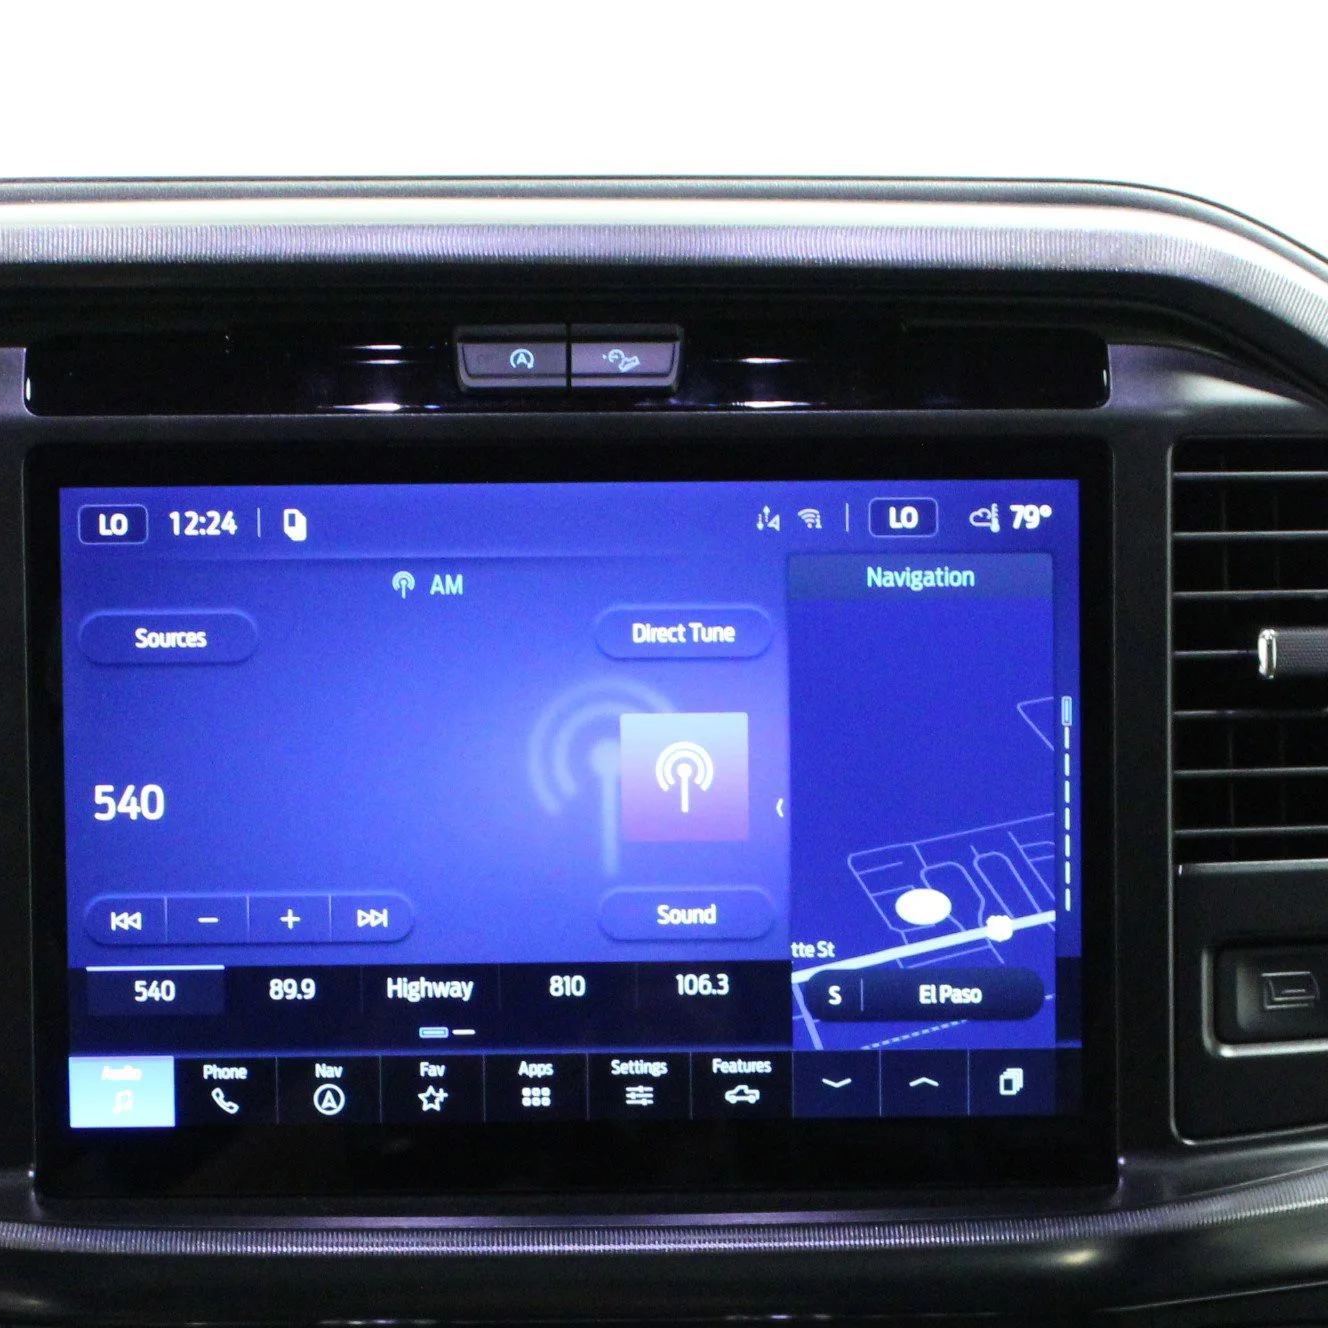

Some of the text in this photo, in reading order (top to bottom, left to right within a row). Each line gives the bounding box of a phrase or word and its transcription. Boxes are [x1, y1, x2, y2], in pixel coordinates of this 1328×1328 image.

[99, 513, 128, 535] LO
[170, 511, 237, 535] 12:24
[889, 506, 918, 529] LO
[430, 574, 463, 594] AM
[867, 567, 975, 591] Navigation
[135, 628, 207, 648] Sources
[633, 623, 735, 643] Direct Tune
[95, 784, 164, 820] 540
[657, 904, 716, 924] Sound
[817, 940, 835, 958] St
[135, 980, 175, 1002] 540
[270, 978, 315, 1000] 89.9
[387, 977, 473, 1002] Highway
[550, 975, 586, 996] 810
[676, 974, 729, 995] 106.3
[919, 983, 982, 1005] El Paso
[829, 986, 841, 1005] S
[203, 1064, 247, 1079] Phone
[315, 1064, 343, 1078] Nav
[420, 1062, 445, 1077] Fav
[518, 1061, 553, 1078] Apps
[611, 1060, 668, 1077] Settings
[712, 1058, 771, 1073] Features
